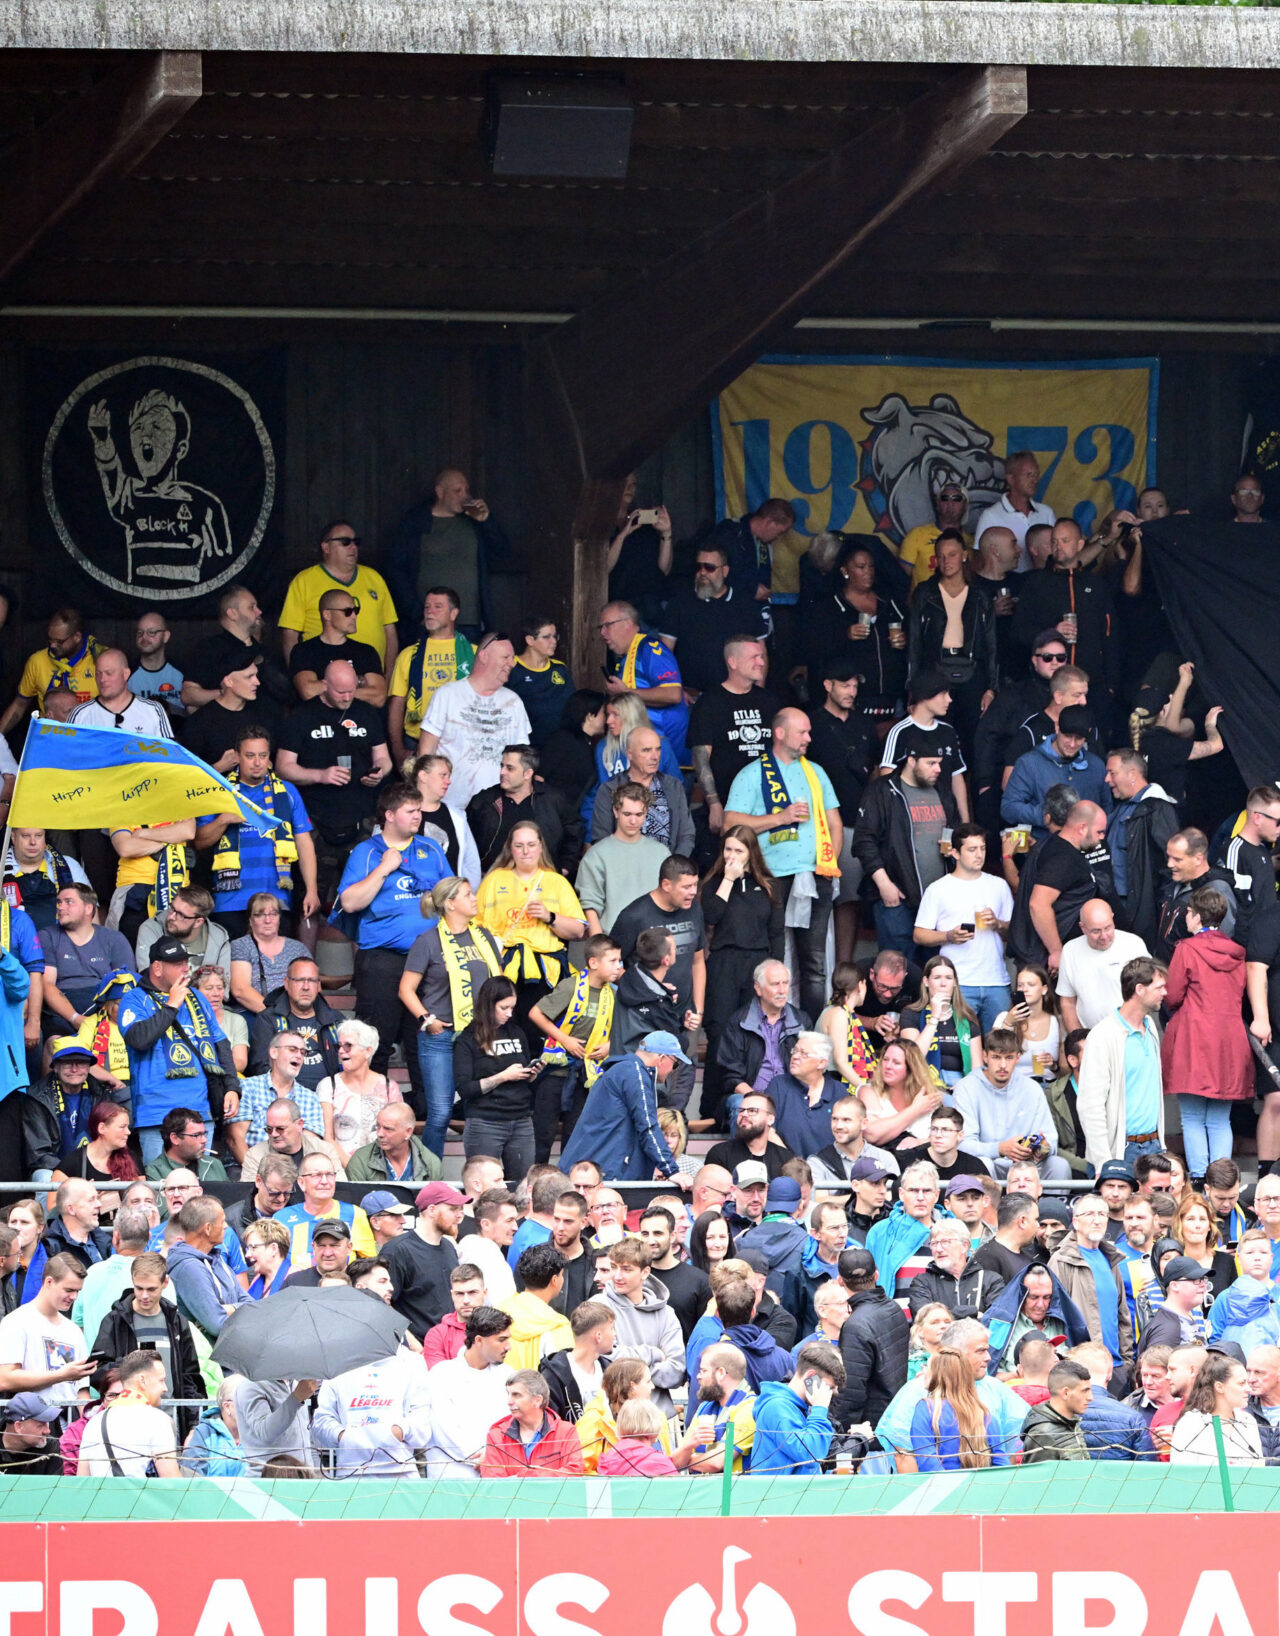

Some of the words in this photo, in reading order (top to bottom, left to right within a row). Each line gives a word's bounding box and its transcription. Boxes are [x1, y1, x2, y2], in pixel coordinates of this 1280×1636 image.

[730, 419, 858, 538] 19
[1006, 424, 1137, 538] 73
[427, 653, 456, 662] ATLAS
[733, 709, 761, 720] ATLAS
[311, 725, 367, 739] ellse
[350, 1398, 393, 1408] LEAGUE
